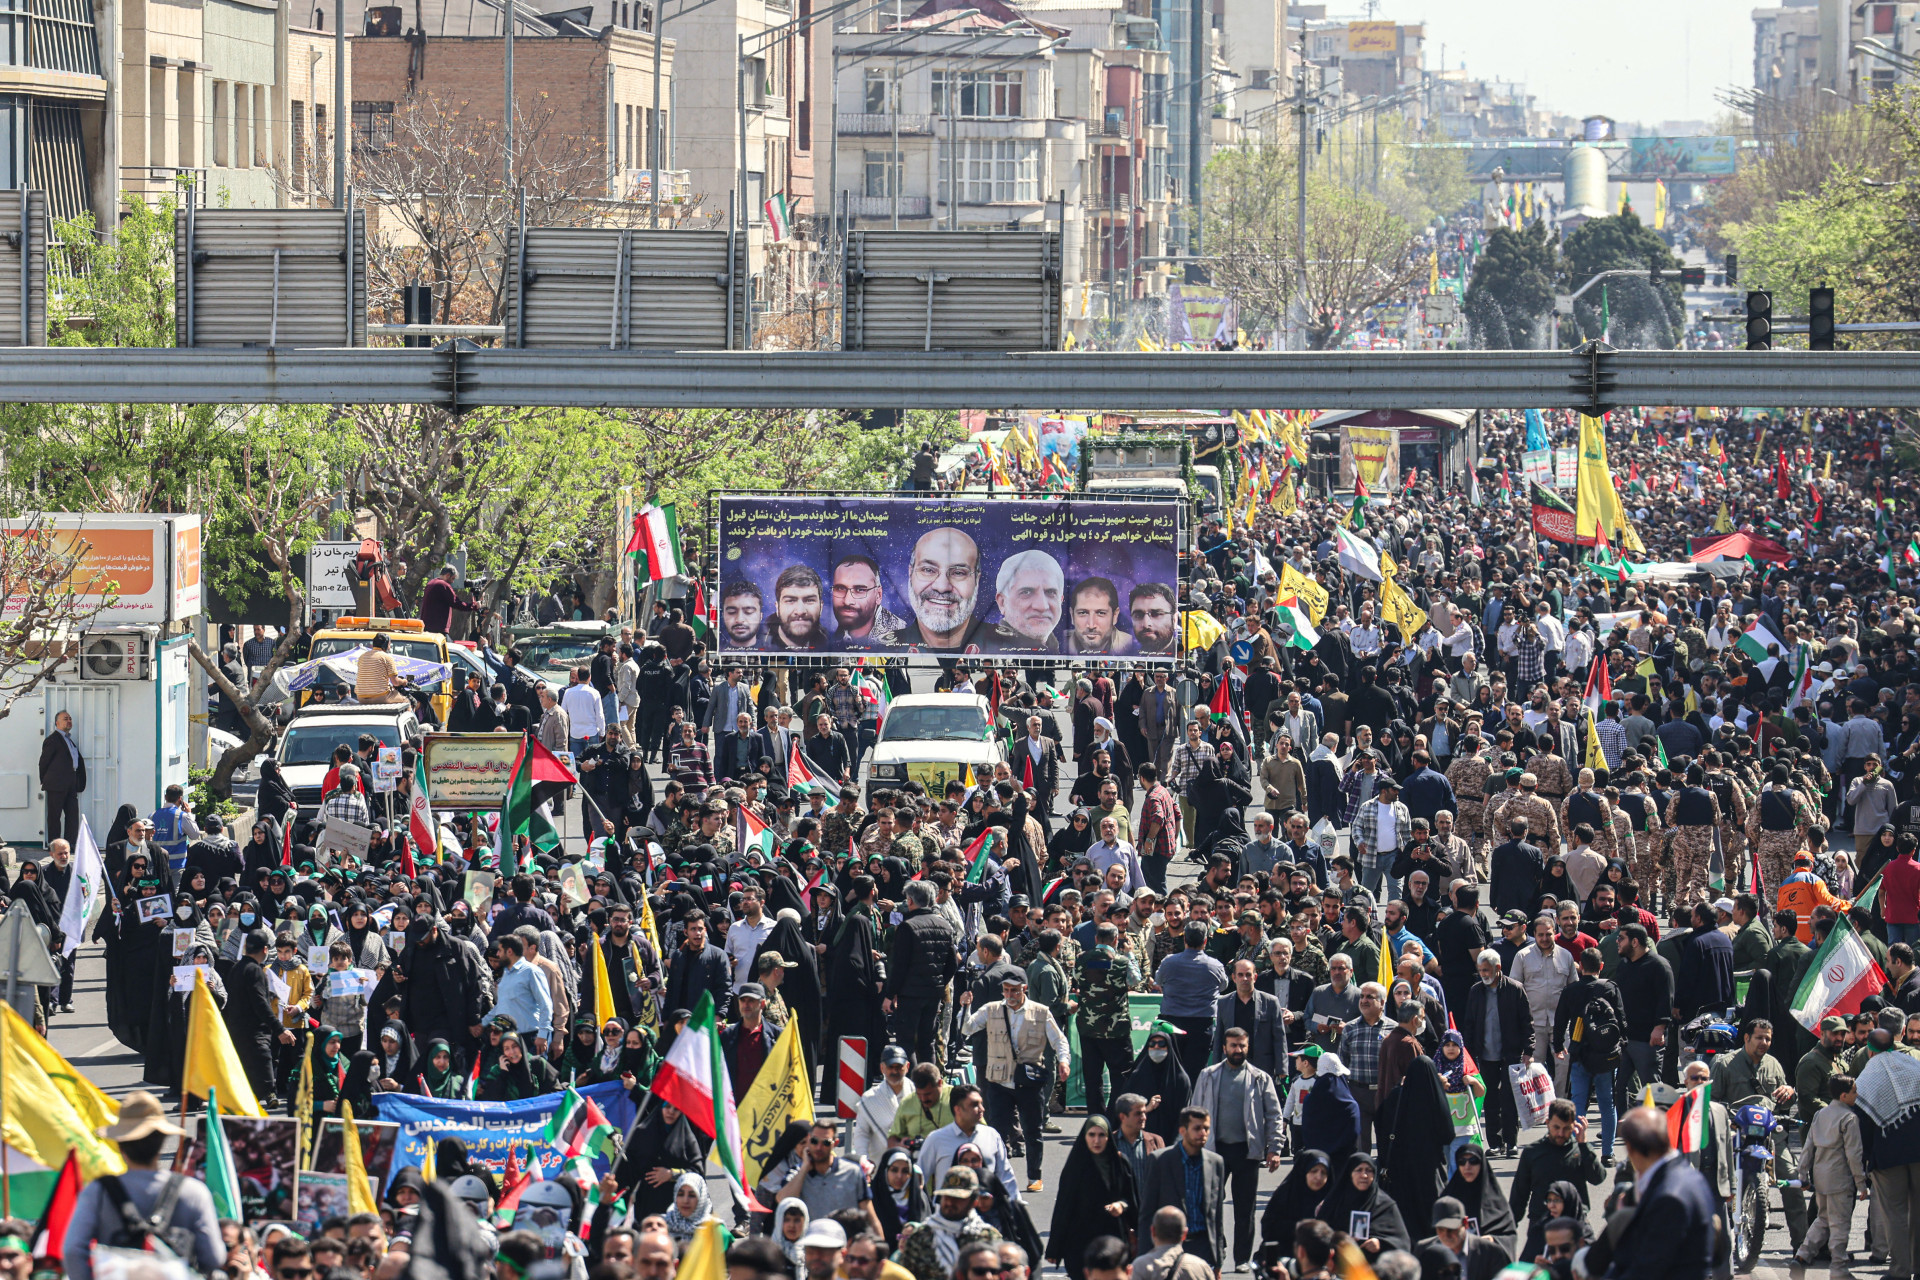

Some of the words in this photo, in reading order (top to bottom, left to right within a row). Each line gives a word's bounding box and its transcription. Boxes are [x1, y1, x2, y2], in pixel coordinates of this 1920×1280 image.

[1353, 36, 1392, 48] رزمندگان
[809, 510, 839, 522] خداوند
[840, 510, 848, 523] از
[850, 511, 858, 520] ما
[858, 511, 889, 523] شهیدان
[1011, 512, 1038, 524] جنایت
[1040, 513, 1054, 524] این
[1058, 513, 1066, 525] از
[1070, 513, 1078, 525] را
[1080, 514, 1126, 526] صهیونیستی
[1128, 514, 1150, 525] خبیث
[1154, 516, 1173, 526] رژیم
[1012, 529, 1032, 541] الهی
[1034, 529, 1048, 541] قوه
[1050, 534, 1055, 542] و
[1057, 530, 1076, 542] حول
[1078, 531, 1086, 542] به
[1112, 531, 1142, 543] خواهیم
[1144, 531, 1173, 544] پشیمان
[324, 548, 342, 556] خان
[343, 548, 358, 559] ریم
[325, 566, 339, 576] تیر
[431, 761, 462, 771] المقدس
[464, 763, 478, 772] بیت
[437, 776, 449, 784] عقیل
[764, 1100, 782, 1126] שלכם
[405, 1116, 484, 1136] المقدس
[486, 1120, 523, 1134] بیت
[490, 1144, 495, 1152] و
[541, 1152, 562, 1168] مرکز
